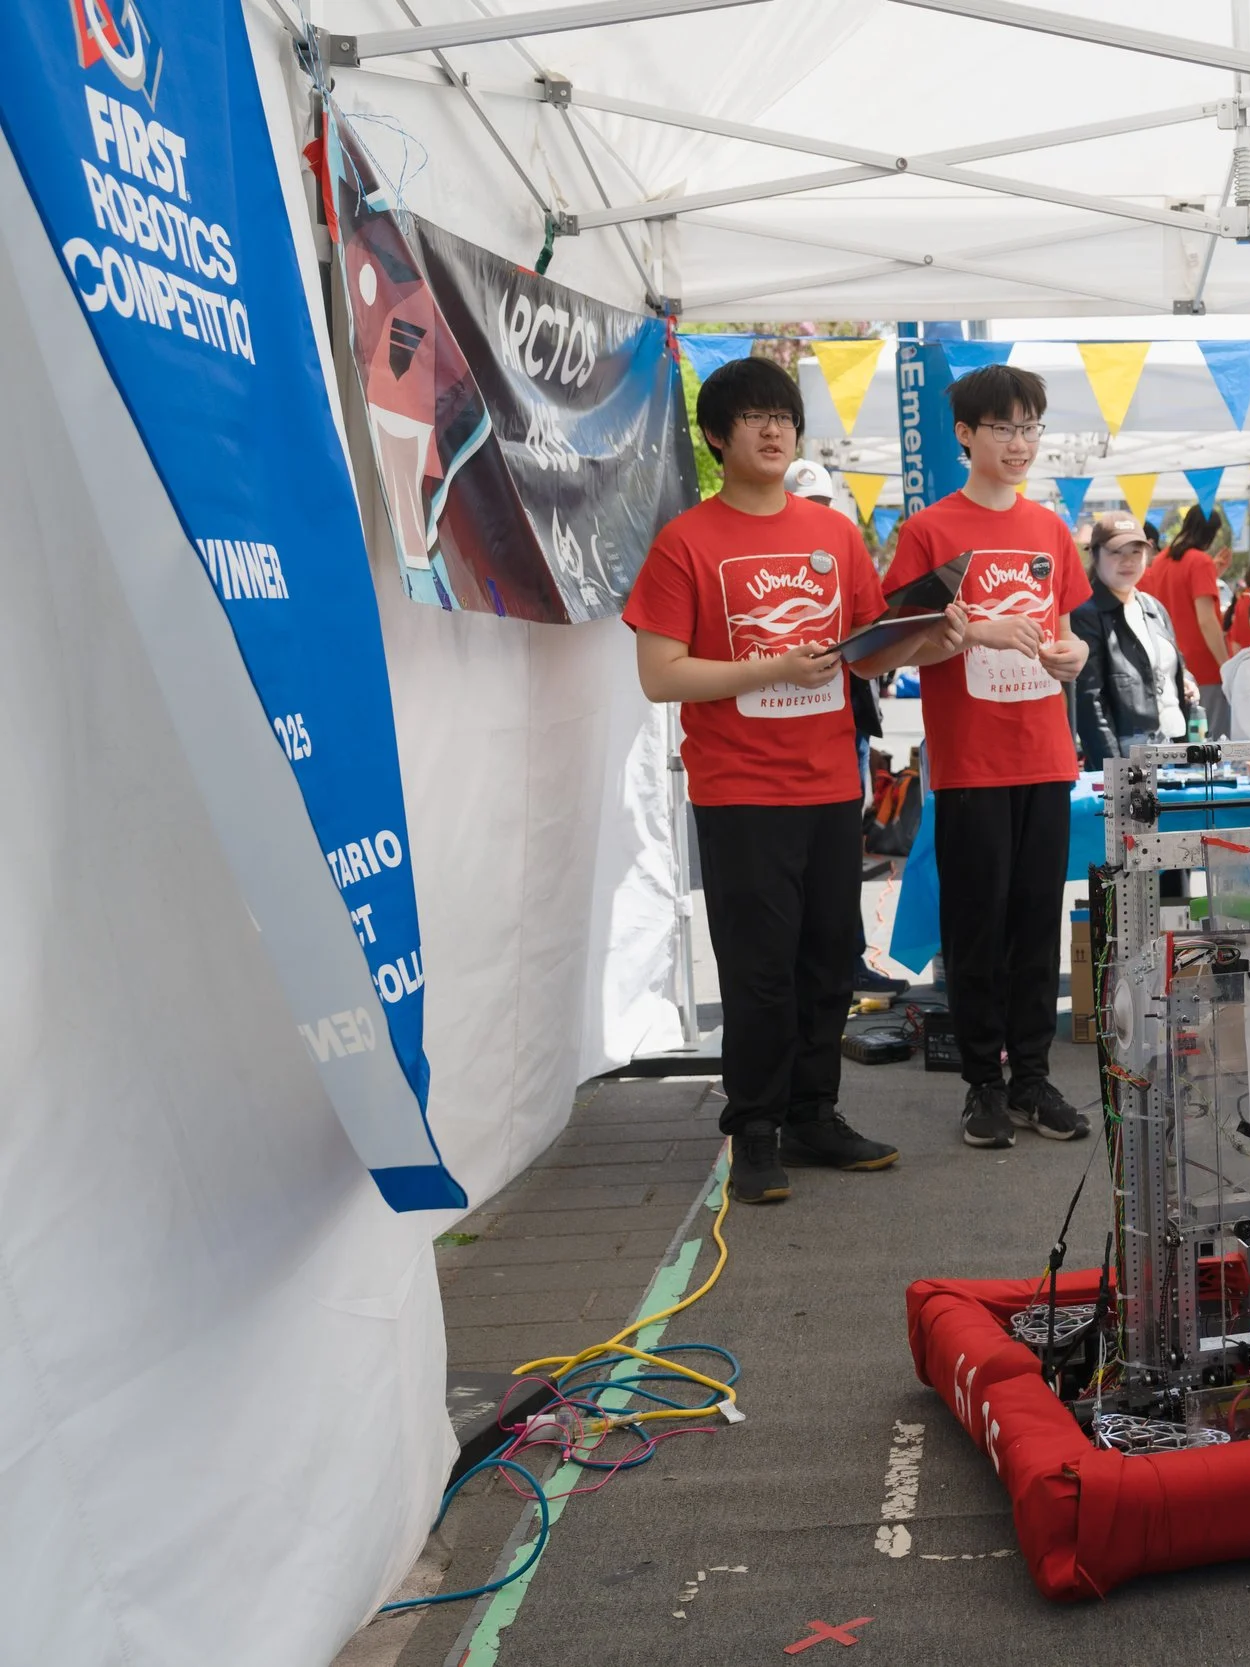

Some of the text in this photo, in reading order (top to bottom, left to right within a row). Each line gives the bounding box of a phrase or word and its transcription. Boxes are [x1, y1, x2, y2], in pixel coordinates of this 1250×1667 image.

[84, 84, 188, 202] FIRST
[81, 158, 238, 286] ROBOTICS
[746, 565, 824, 600] Wonder
[978, 562, 1042, 593] Wonder
[760, 692, 832, 708] RENDEZVOUS
